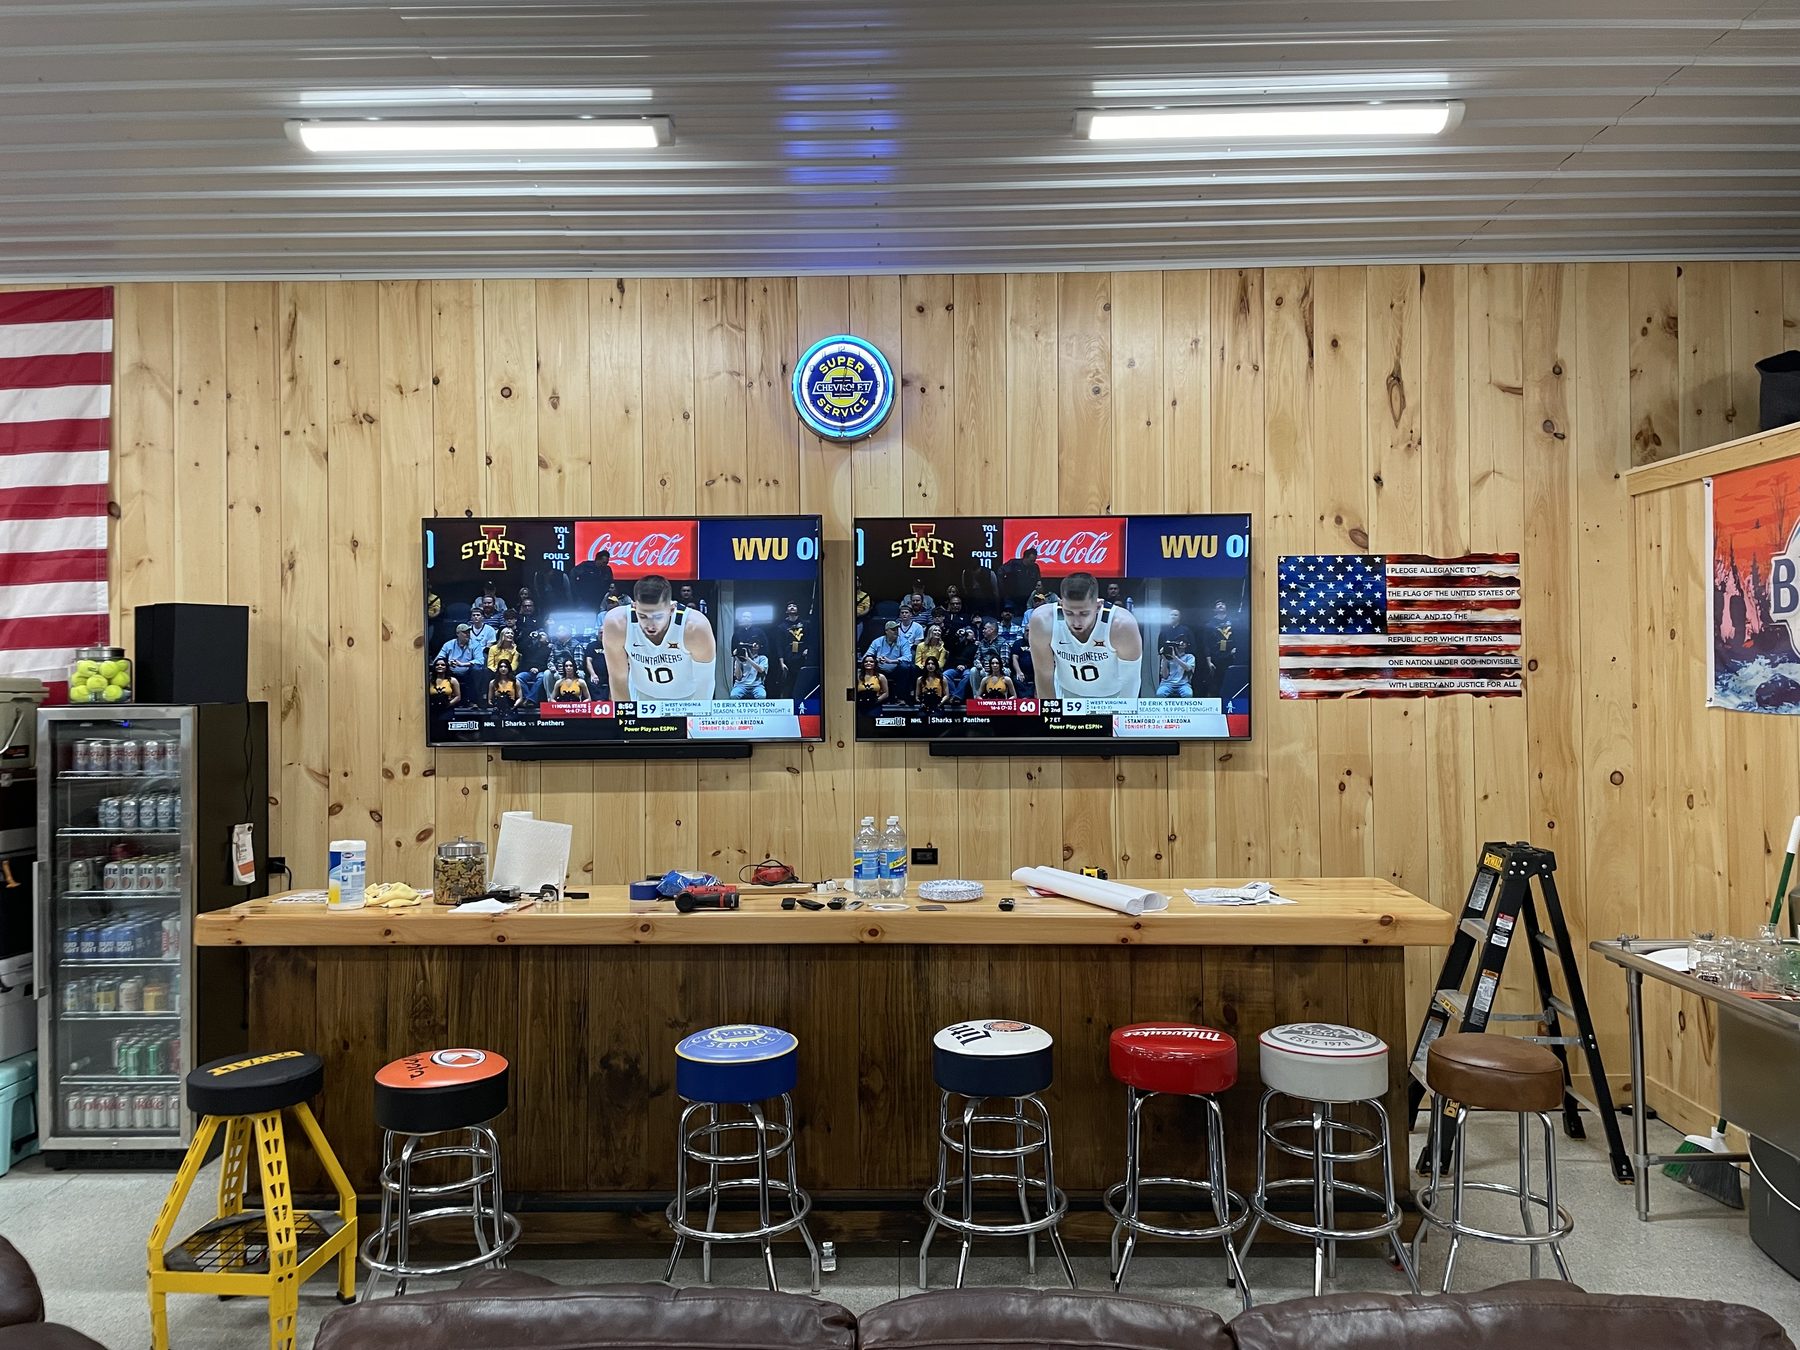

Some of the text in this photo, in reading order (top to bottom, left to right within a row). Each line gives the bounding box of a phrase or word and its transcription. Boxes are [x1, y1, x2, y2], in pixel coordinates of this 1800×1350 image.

[819, 356, 865, 374] SUPER
[817, 397, 869, 417] SERVICE
[553, 526, 570, 534] TOL
[557, 534, 565, 550] 3
[891, 538, 954, 558] STATE
[985, 532, 993, 548] 3
[1015, 531, 1113, 565] Coca-Cola
[1160, 535, 1218, 558] WVU
[461, 539, 526, 561] STATE
[587, 533, 684, 567] Coca-Cola
[732, 537, 789, 561] WVU
[631, 652, 683, 665] MOUNTAINEERS
[1057, 650, 1108, 663] MOUNTAINEERS
[644, 667, 674, 684] 10
[1070, 664, 1099, 681] 10
[593, 704, 610, 715] 60
[641, 704, 657, 714] 59
[1020, 701, 1035, 712] 60
[1067, 702, 1082, 711] 59
[706, 1035, 775, 1048] SERVICE
[1122, 1030, 1225, 1041] Milwaukee
